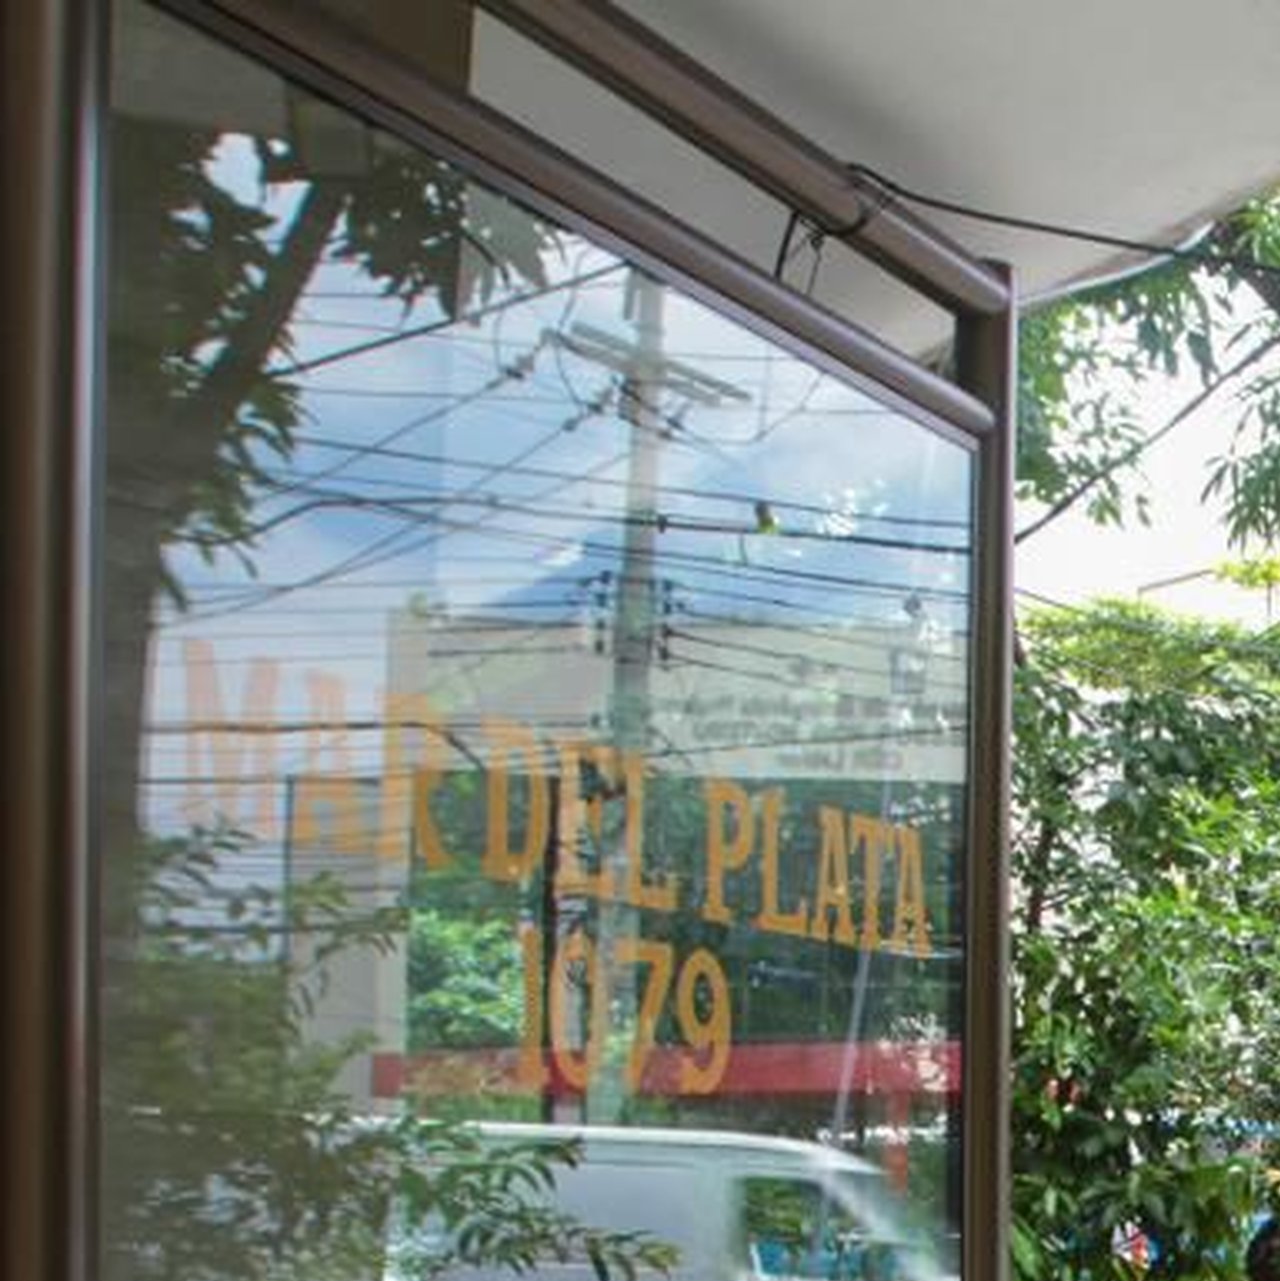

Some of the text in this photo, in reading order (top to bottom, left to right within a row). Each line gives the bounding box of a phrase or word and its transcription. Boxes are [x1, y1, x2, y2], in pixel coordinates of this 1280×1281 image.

[180, 636, 933, 960] MAR DEL PLATA
[518, 920, 732, 1096] 1079
